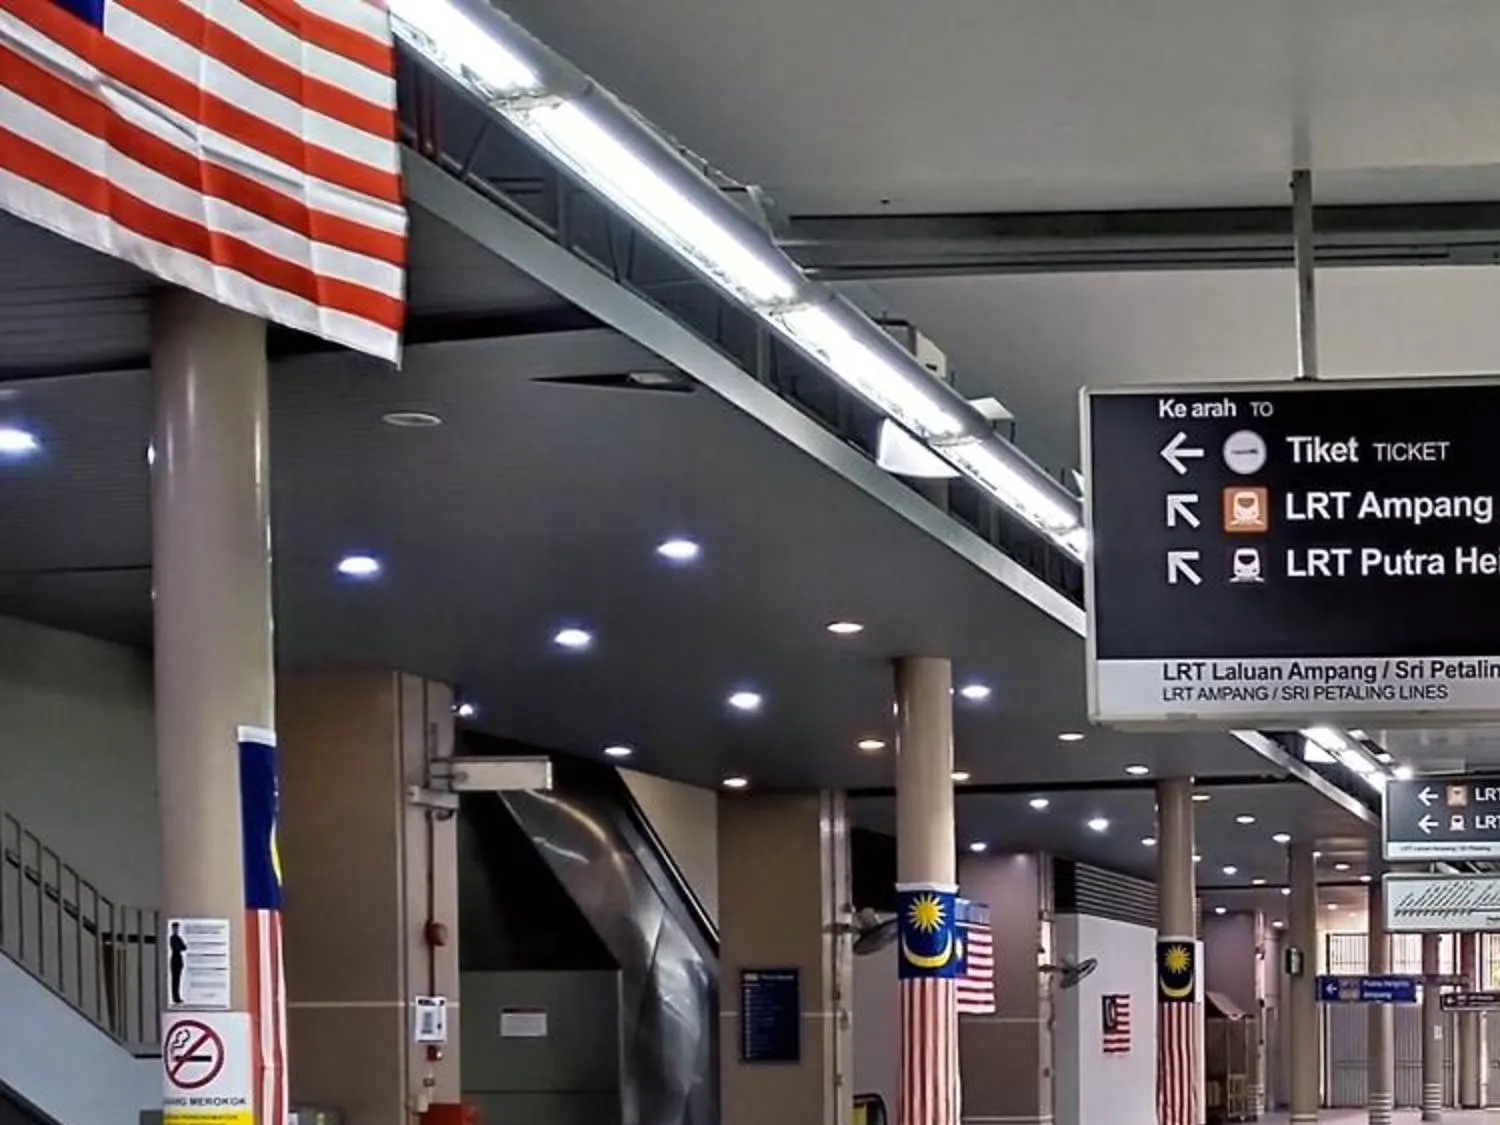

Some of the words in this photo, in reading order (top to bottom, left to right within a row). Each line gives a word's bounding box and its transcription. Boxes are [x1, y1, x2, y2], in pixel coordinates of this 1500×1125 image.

[1159, 398, 1188, 418] Ke
[1191, 397, 1237, 418] arah
[1249, 401, 1274, 417] TO
[1285, 435, 1359, 463] Tiket
[1372, 441, 1450, 461] TICKET
[1286, 491, 1352, 520] LRT
[1357, 491, 1493, 525] Ampang
[1287, 548, 1353, 577] LRT
[1361, 547, 1445, 576] Putra
[1163, 662, 1206, 681] LRT
[1212, 662, 1283, 681] Laluan
[1287, 661, 1377, 685] Ampang
[1395, 660, 1424, 679] Sri
[1163, 686, 1194, 702] LRT
[1197, 685, 1269, 701] AMPANG
[1281, 685, 1309, 701] SRI
[1313, 685, 1395, 701] PETALING
[1399, 684, 1449, 700] LINES
